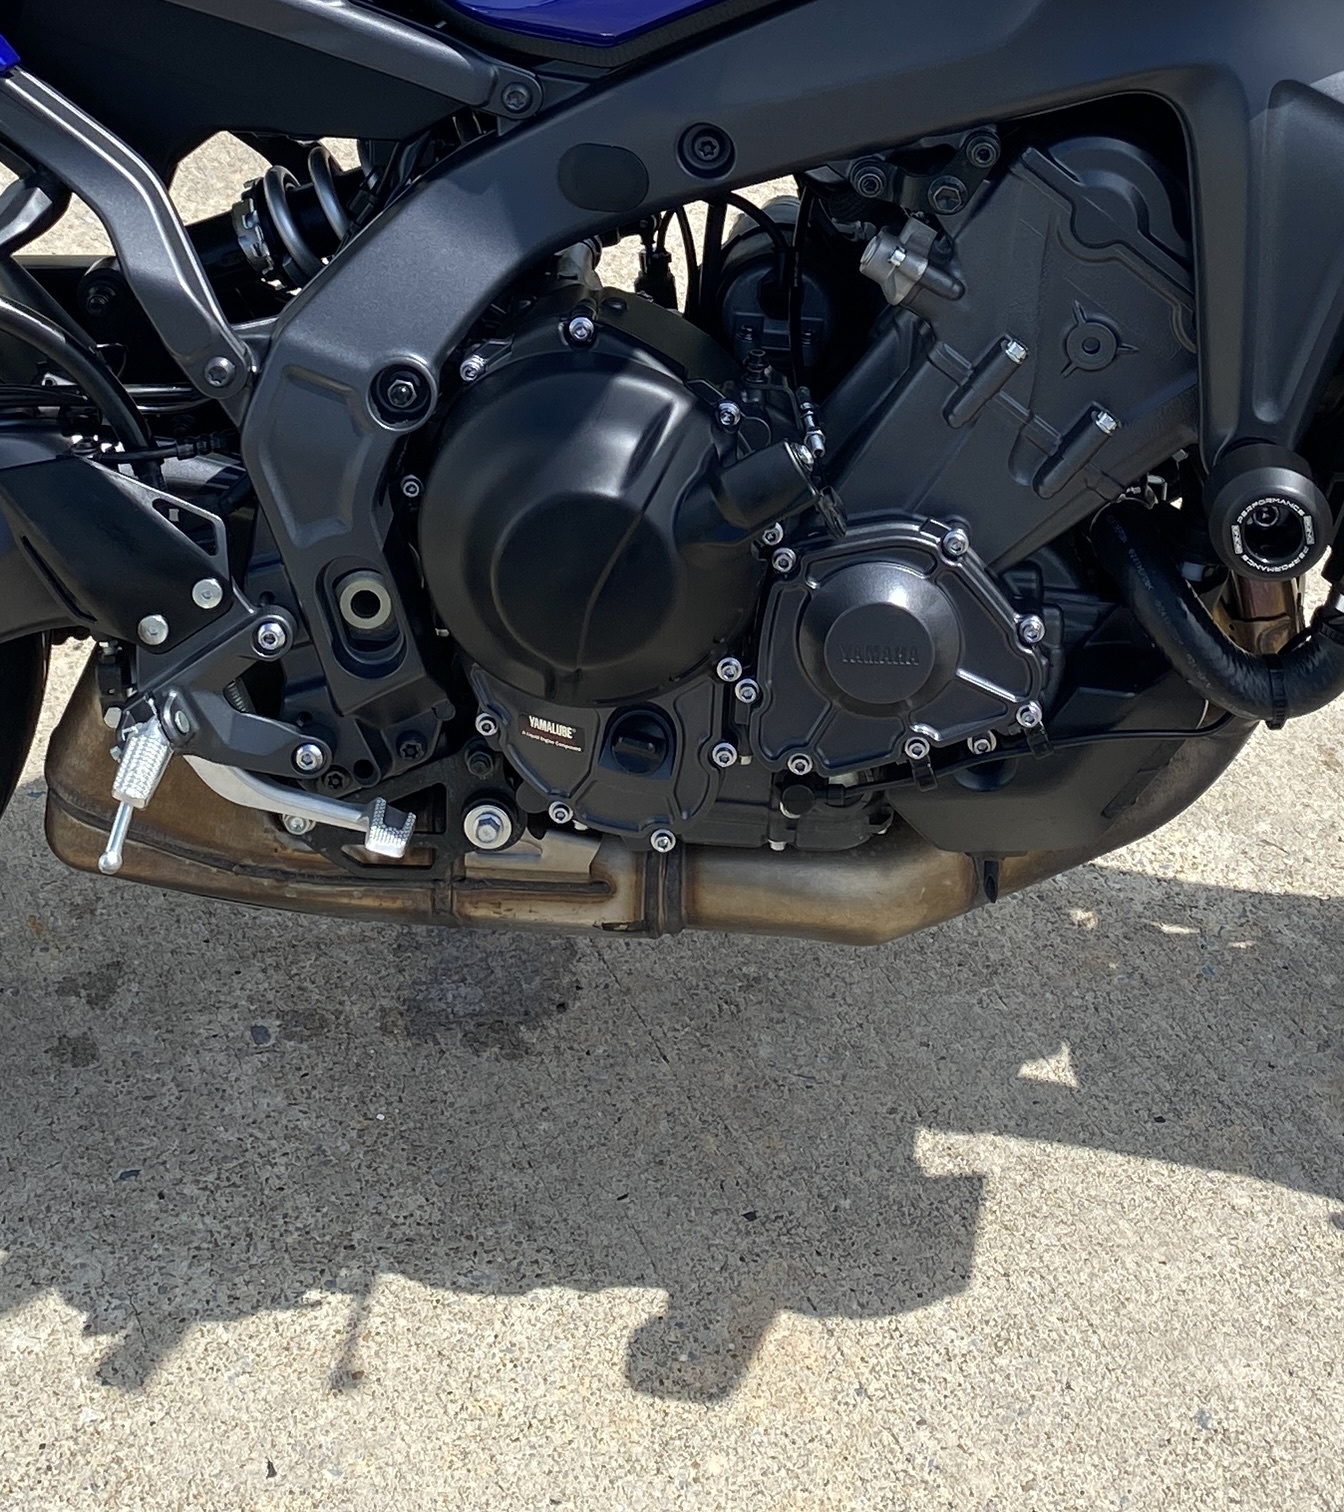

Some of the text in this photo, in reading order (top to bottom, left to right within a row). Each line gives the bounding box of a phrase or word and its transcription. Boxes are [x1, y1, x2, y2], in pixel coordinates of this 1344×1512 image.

[1237, 497, 1305, 524] PERFORMANCE
[1241, 546, 1309, 572] PERFORMANCE
[839, 642, 919, 665] YAMAHA
[528, 715, 573, 739] YAMALUBE
